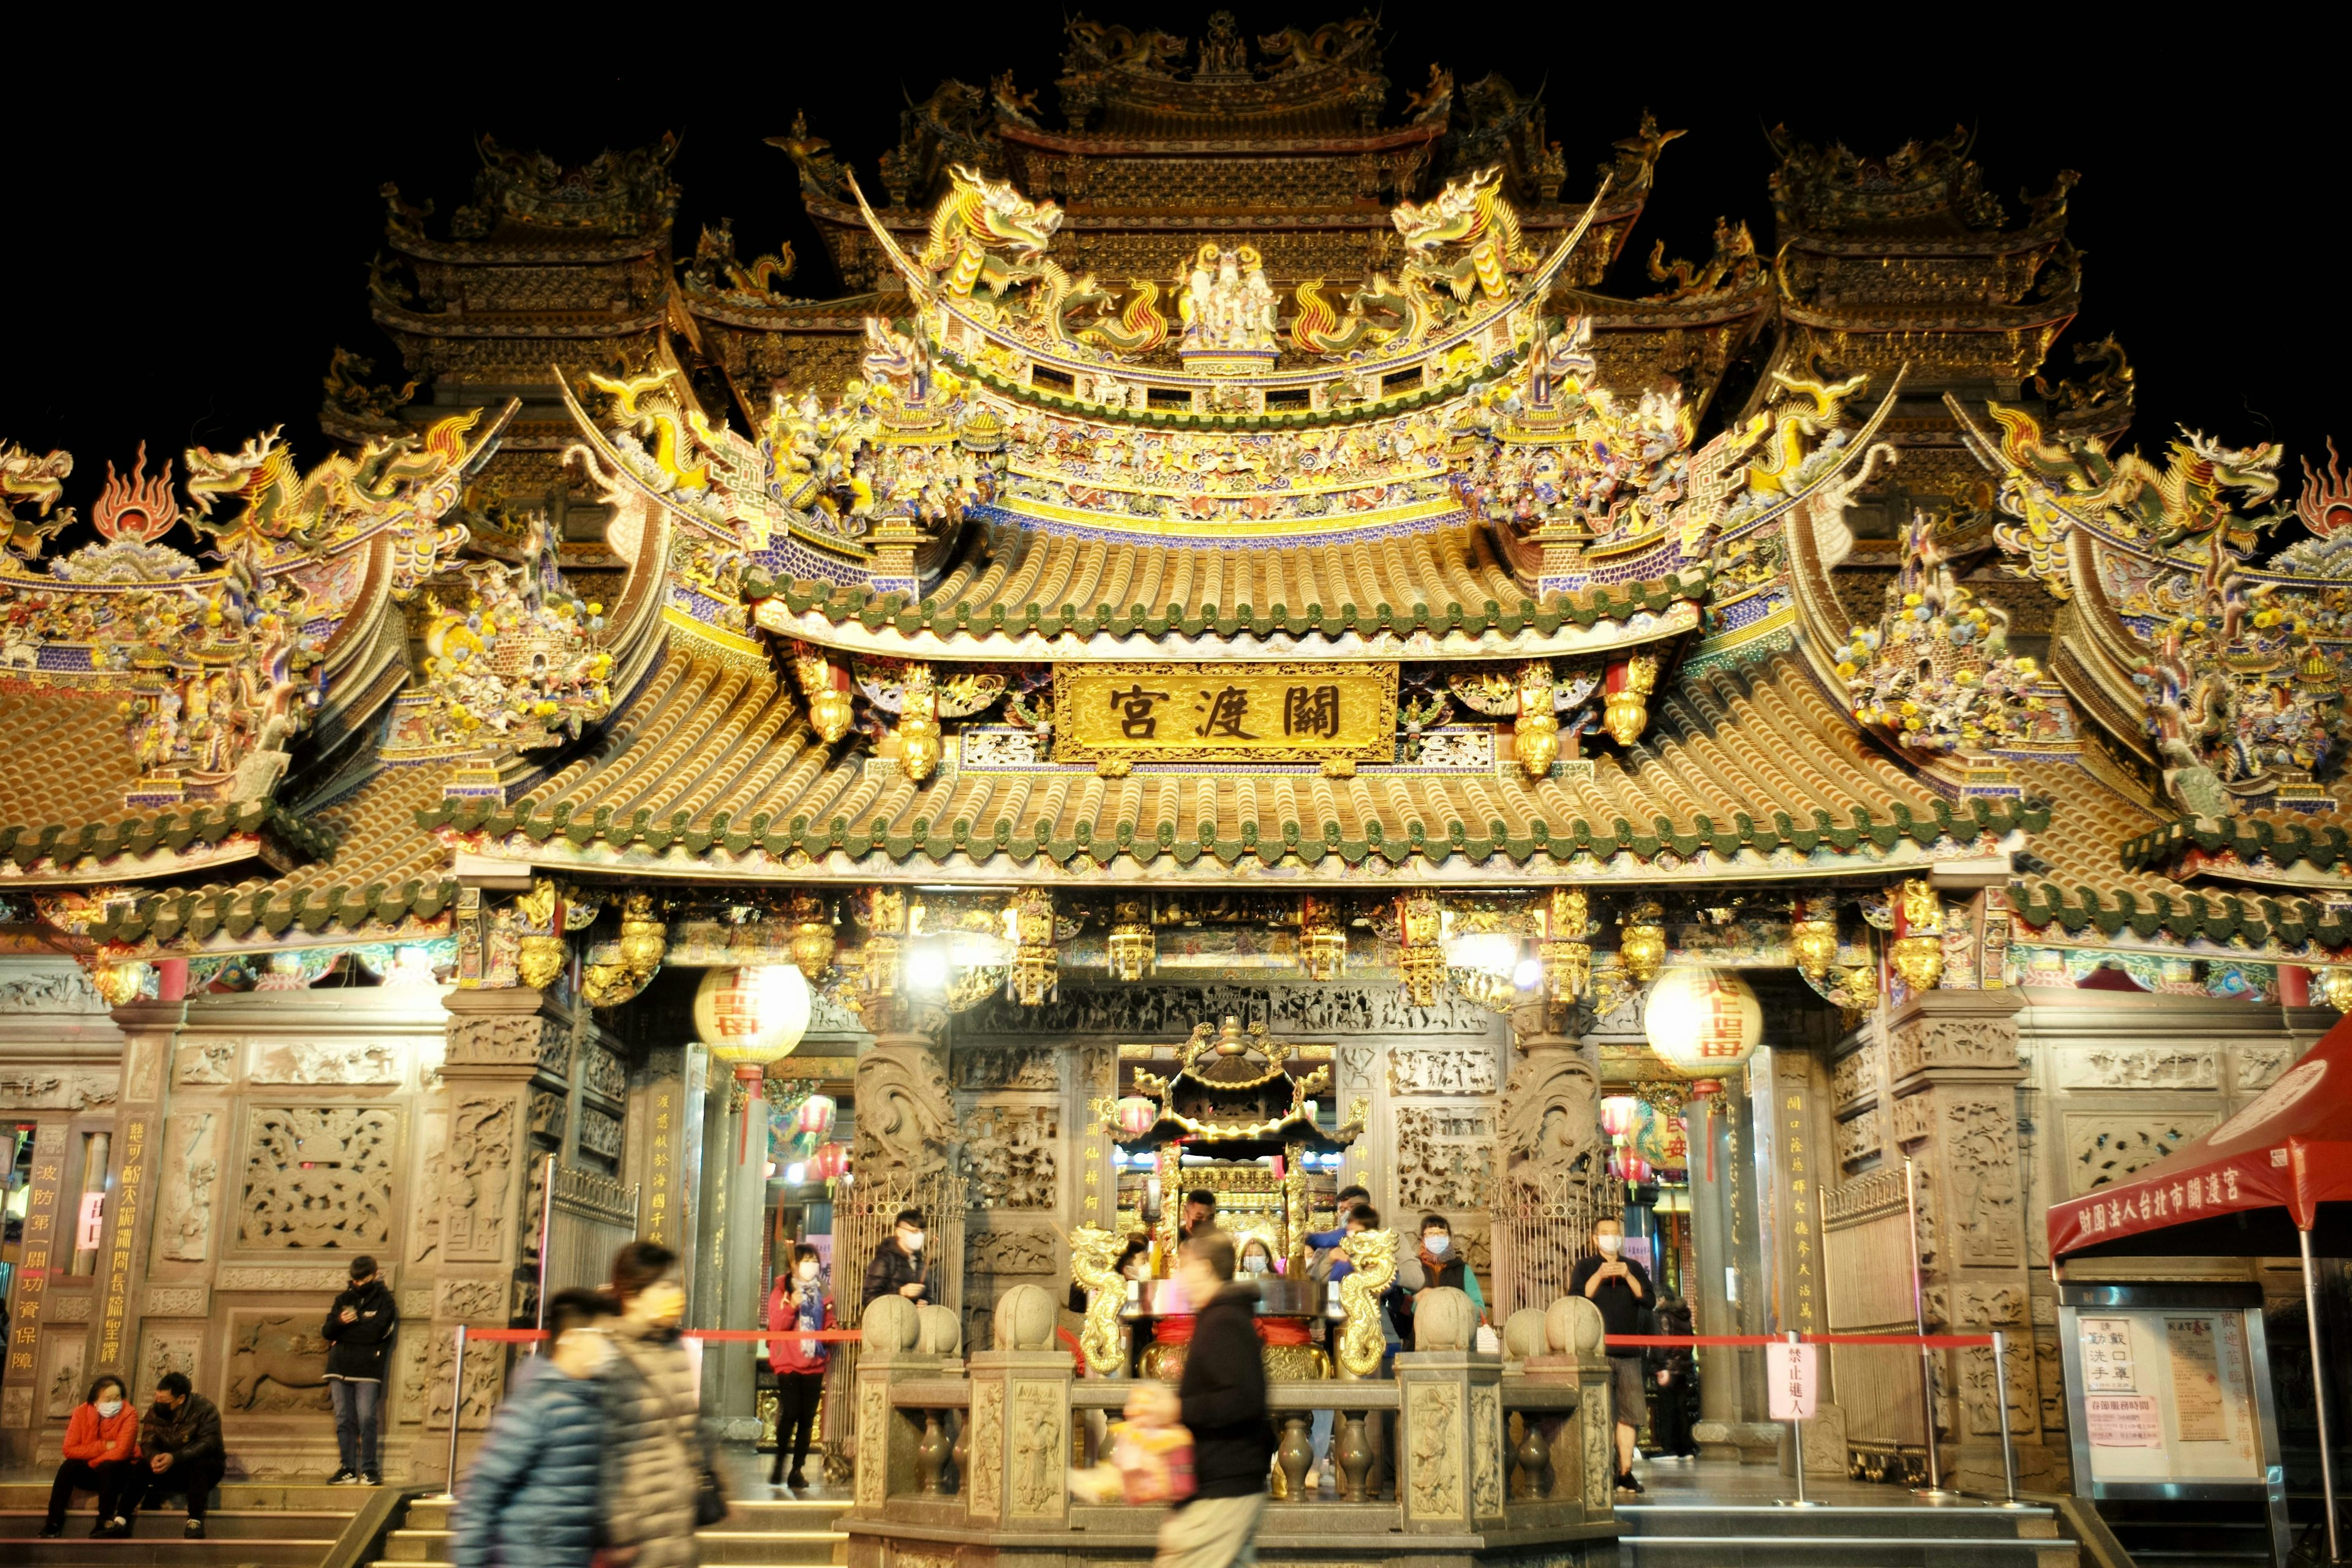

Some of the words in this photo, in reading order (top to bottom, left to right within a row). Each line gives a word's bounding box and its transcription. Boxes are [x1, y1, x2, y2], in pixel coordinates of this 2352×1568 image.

[1110, 684, 1340, 740] 關渡宮
[1693, 978, 1743, 1058] 天上聖母
[2078, 1167, 2239, 1235] 財團法人台北市關渡宮
[12, 1164, 58, 1369] 波防第一關功資保障
[1789, 1348, 1803, 1415] 禁止進入
[2092, 1401, 2149, 1410] 春節服務時間
